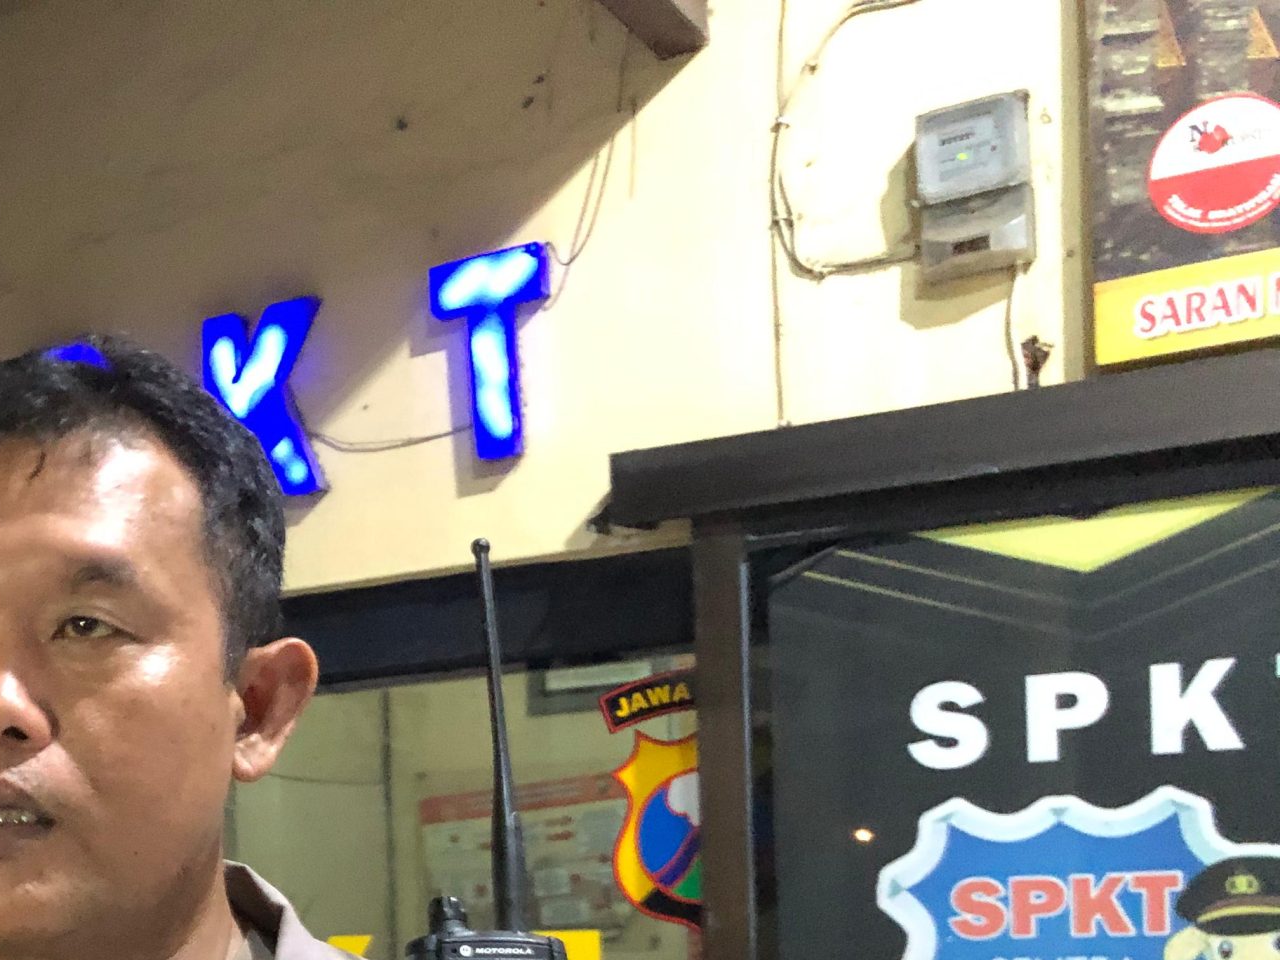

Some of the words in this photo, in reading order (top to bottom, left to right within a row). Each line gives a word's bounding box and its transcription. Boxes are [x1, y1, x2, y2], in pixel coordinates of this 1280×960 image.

[1139, 282, 1258, 334] SARAN
[615, 682, 690, 718] JAWA
[906, 653, 1280, 771] SPK
[947, 871, 1184, 940] SPKT
[475, 947, 534, 955] MOTOROLA
